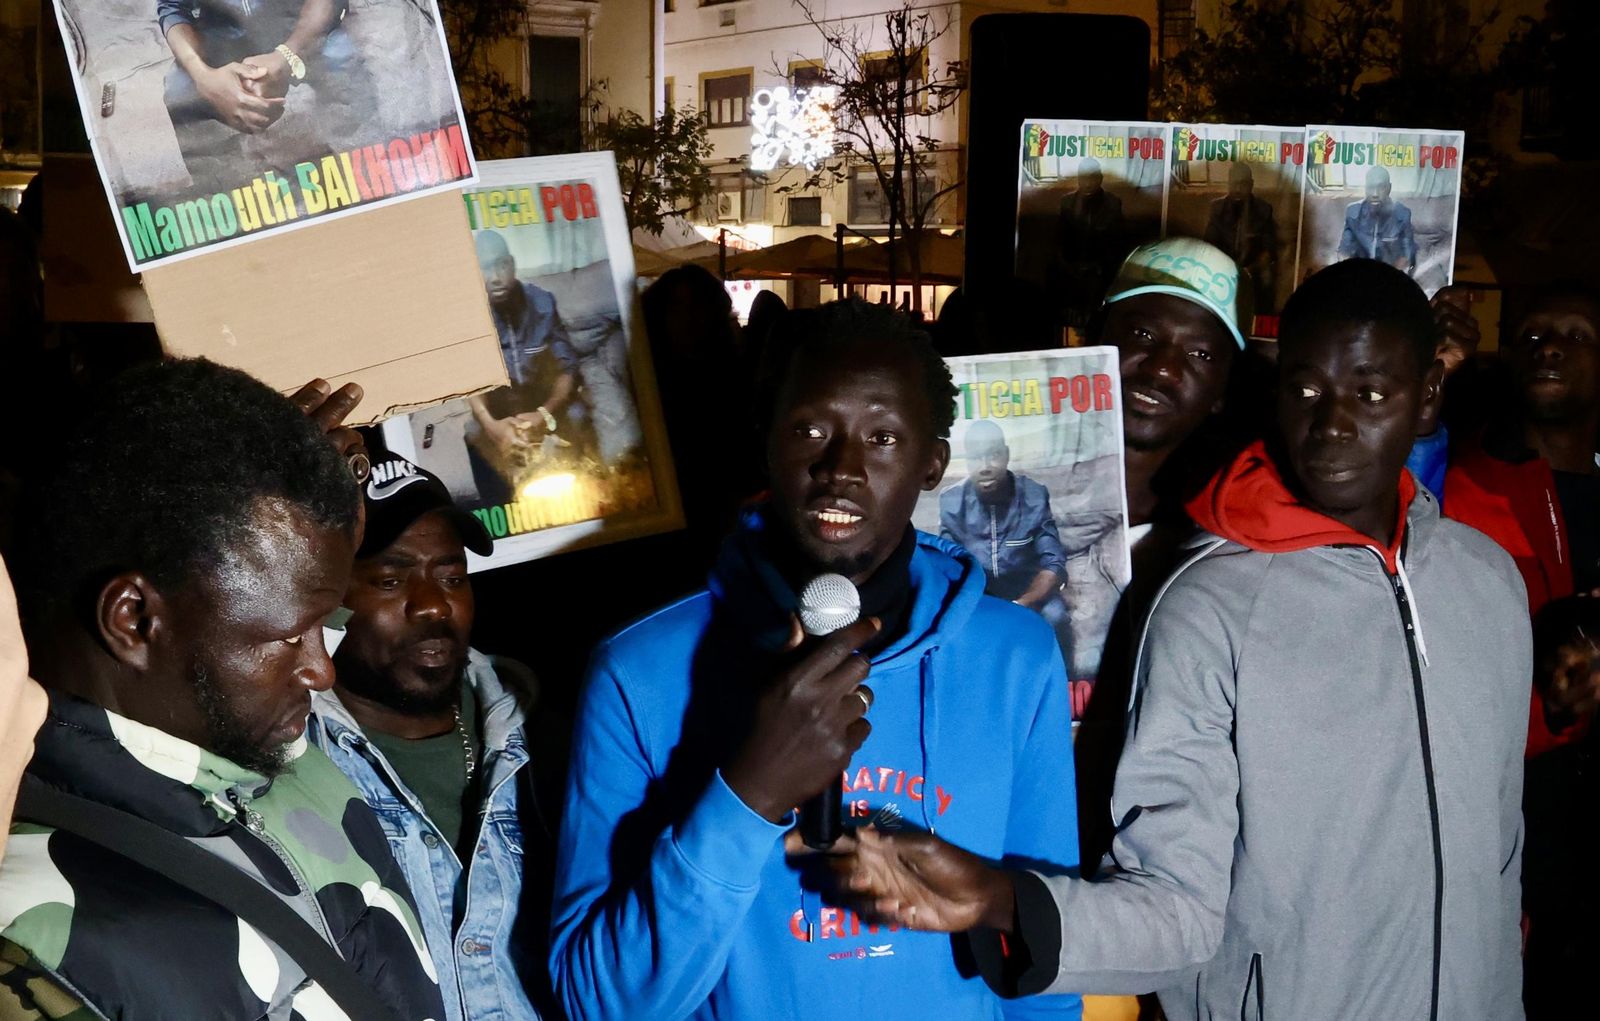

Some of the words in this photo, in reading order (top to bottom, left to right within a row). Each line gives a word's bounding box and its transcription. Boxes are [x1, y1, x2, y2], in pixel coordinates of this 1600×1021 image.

[1047, 135, 1125, 158] JUSTICIA
[1128, 137, 1164, 160] POR
[1197, 138, 1276, 163] JUSTICIA
[1280, 142, 1304, 165] PO
[1332, 141, 1416, 167] JUSTICIA
[1419, 144, 1458, 169] POR
[122, 170, 299, 261] Mamouth
[462, 188, 540, 230] TICIA
[540, 182, 600, 223] POR
[954, 379, 1045, 420] TICIA
[1048, 373, 1114, 415] POR
[850, 799, 870, 818] IS
